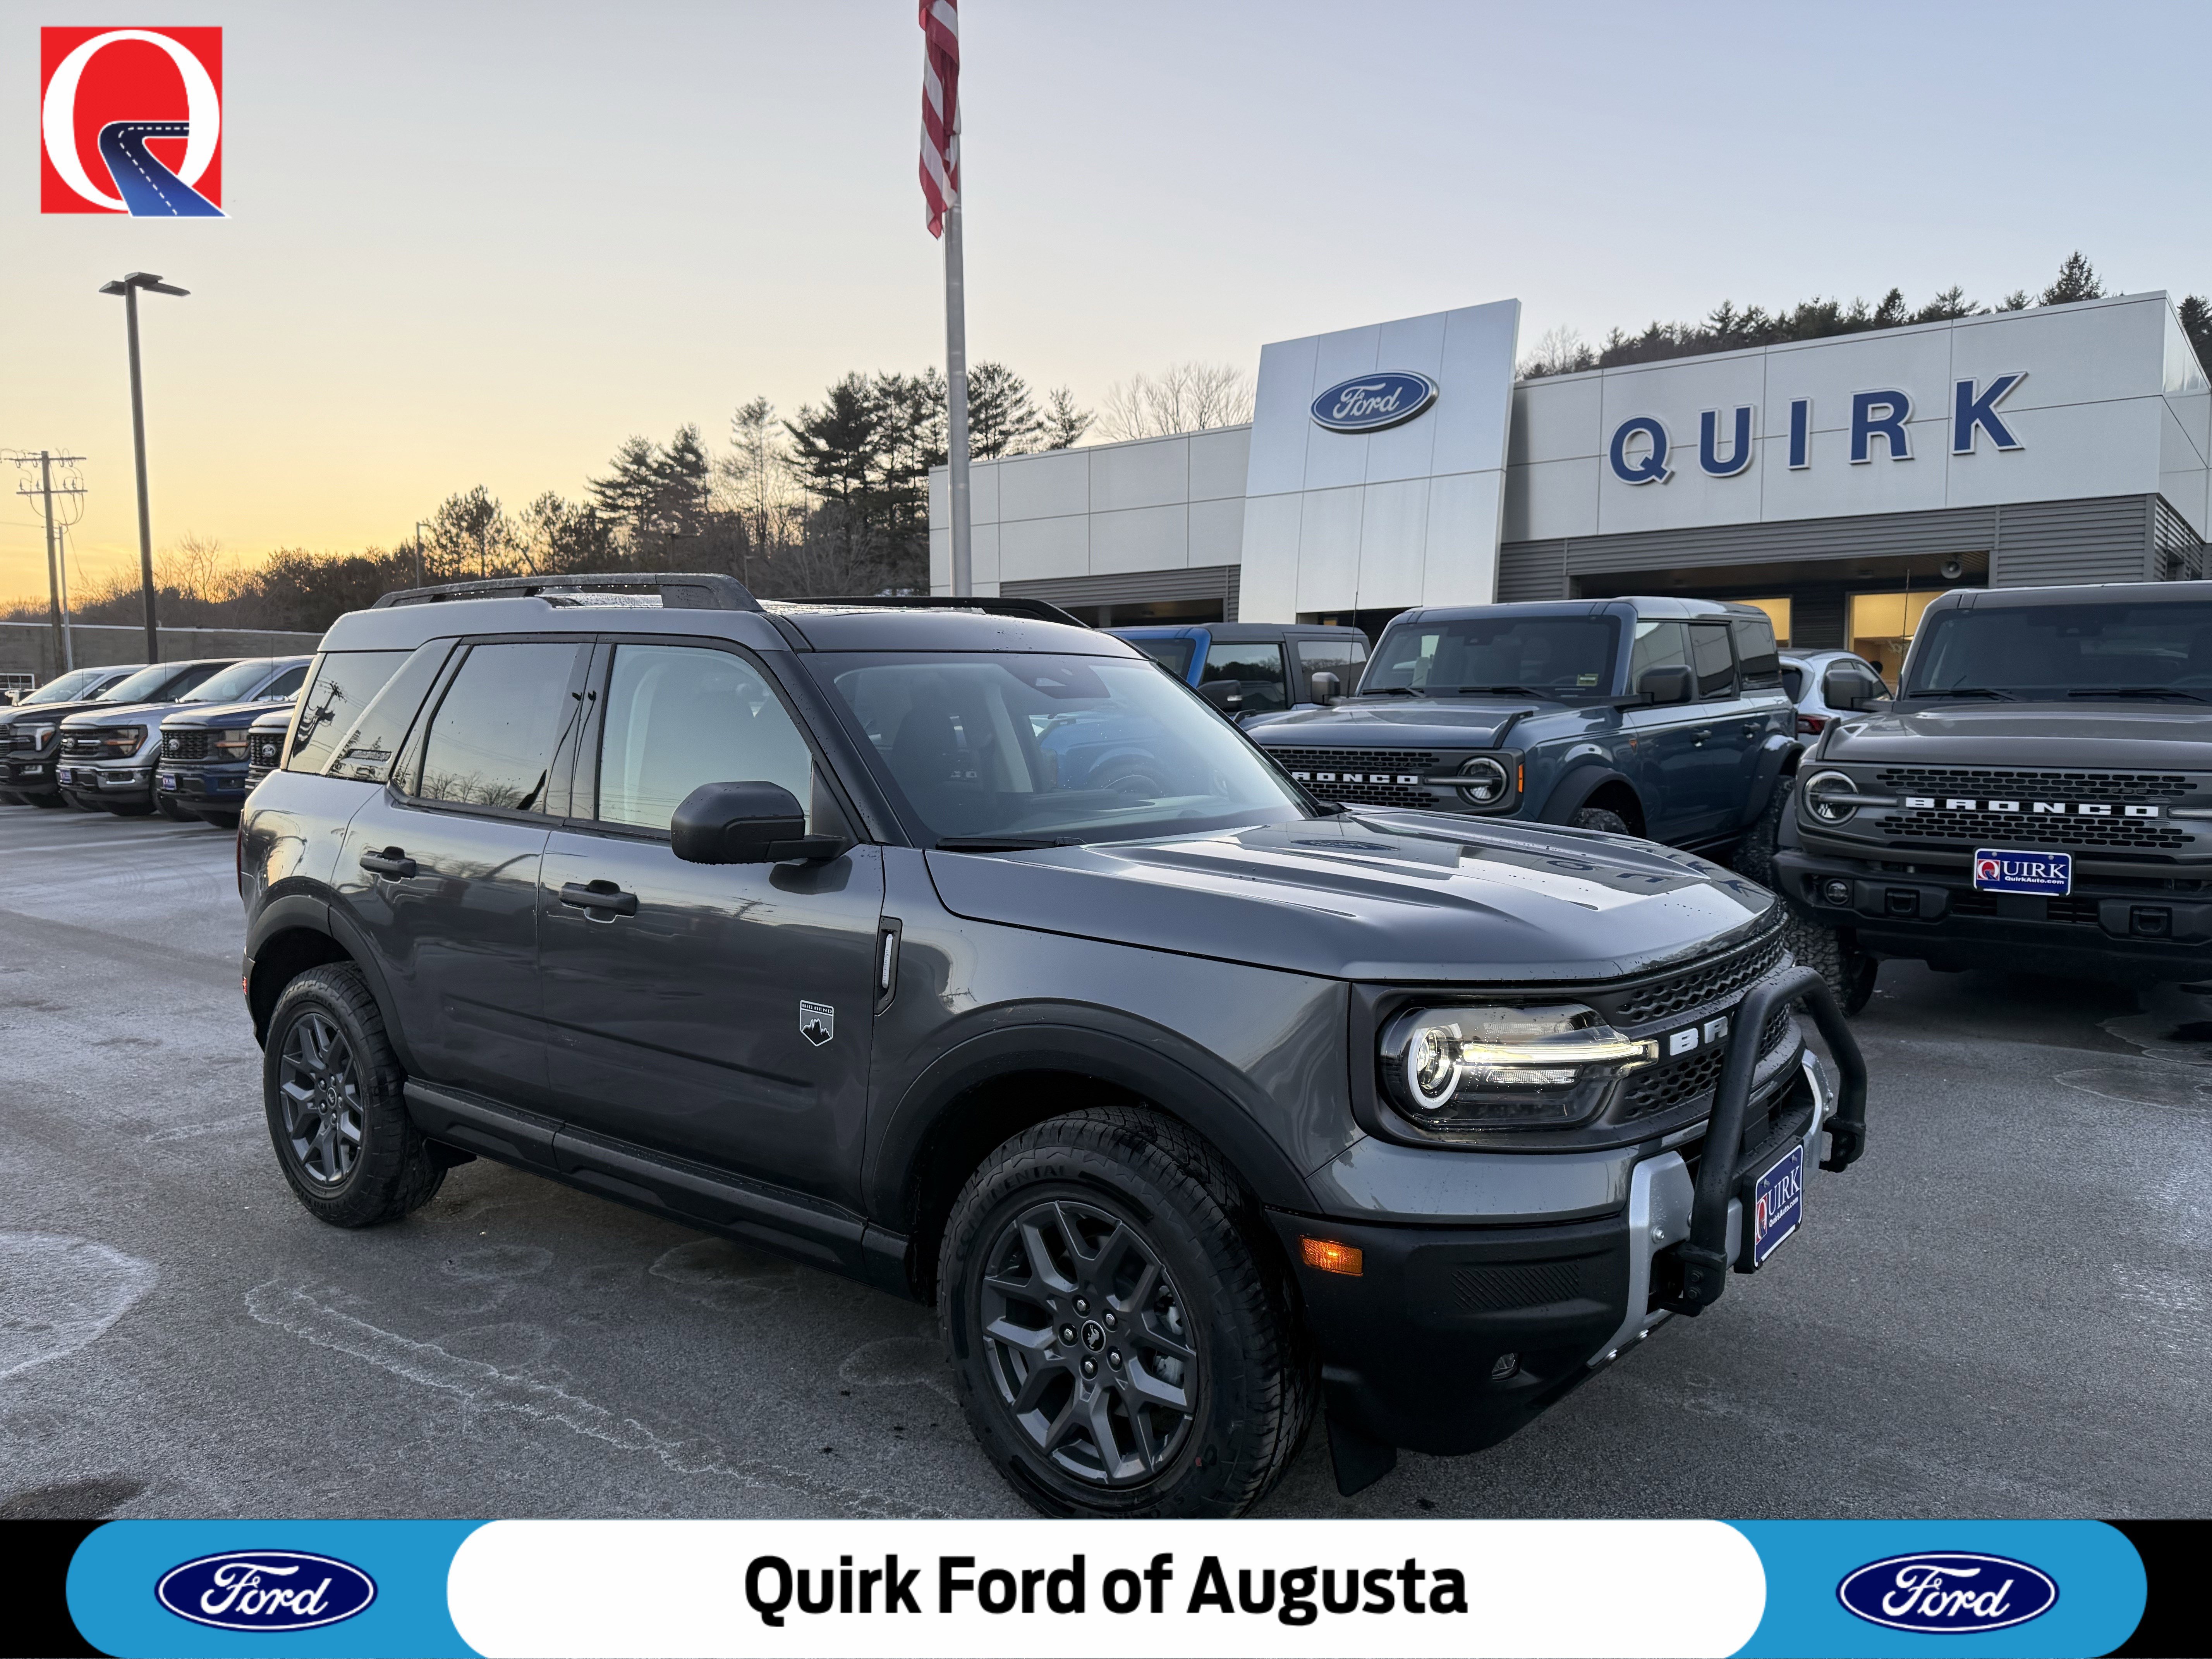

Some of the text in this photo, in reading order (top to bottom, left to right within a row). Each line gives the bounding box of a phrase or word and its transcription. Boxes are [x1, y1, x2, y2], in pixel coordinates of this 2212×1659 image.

[1332, 382, 1403, 419] Ford
[1608, 371, 2028, 486] QUIRK
[1292, 771, 1418, 785] RONCO
[1906, 797, 2159, 817] BRONCO
[1977, 860, 2068, 881] QUIRK
[2004, 876, 2064, 884] QuirkAuto.com
[1670, 1011, 1735, 1056] BR
[1757, 1165, 1800, 1240] QUIRK
